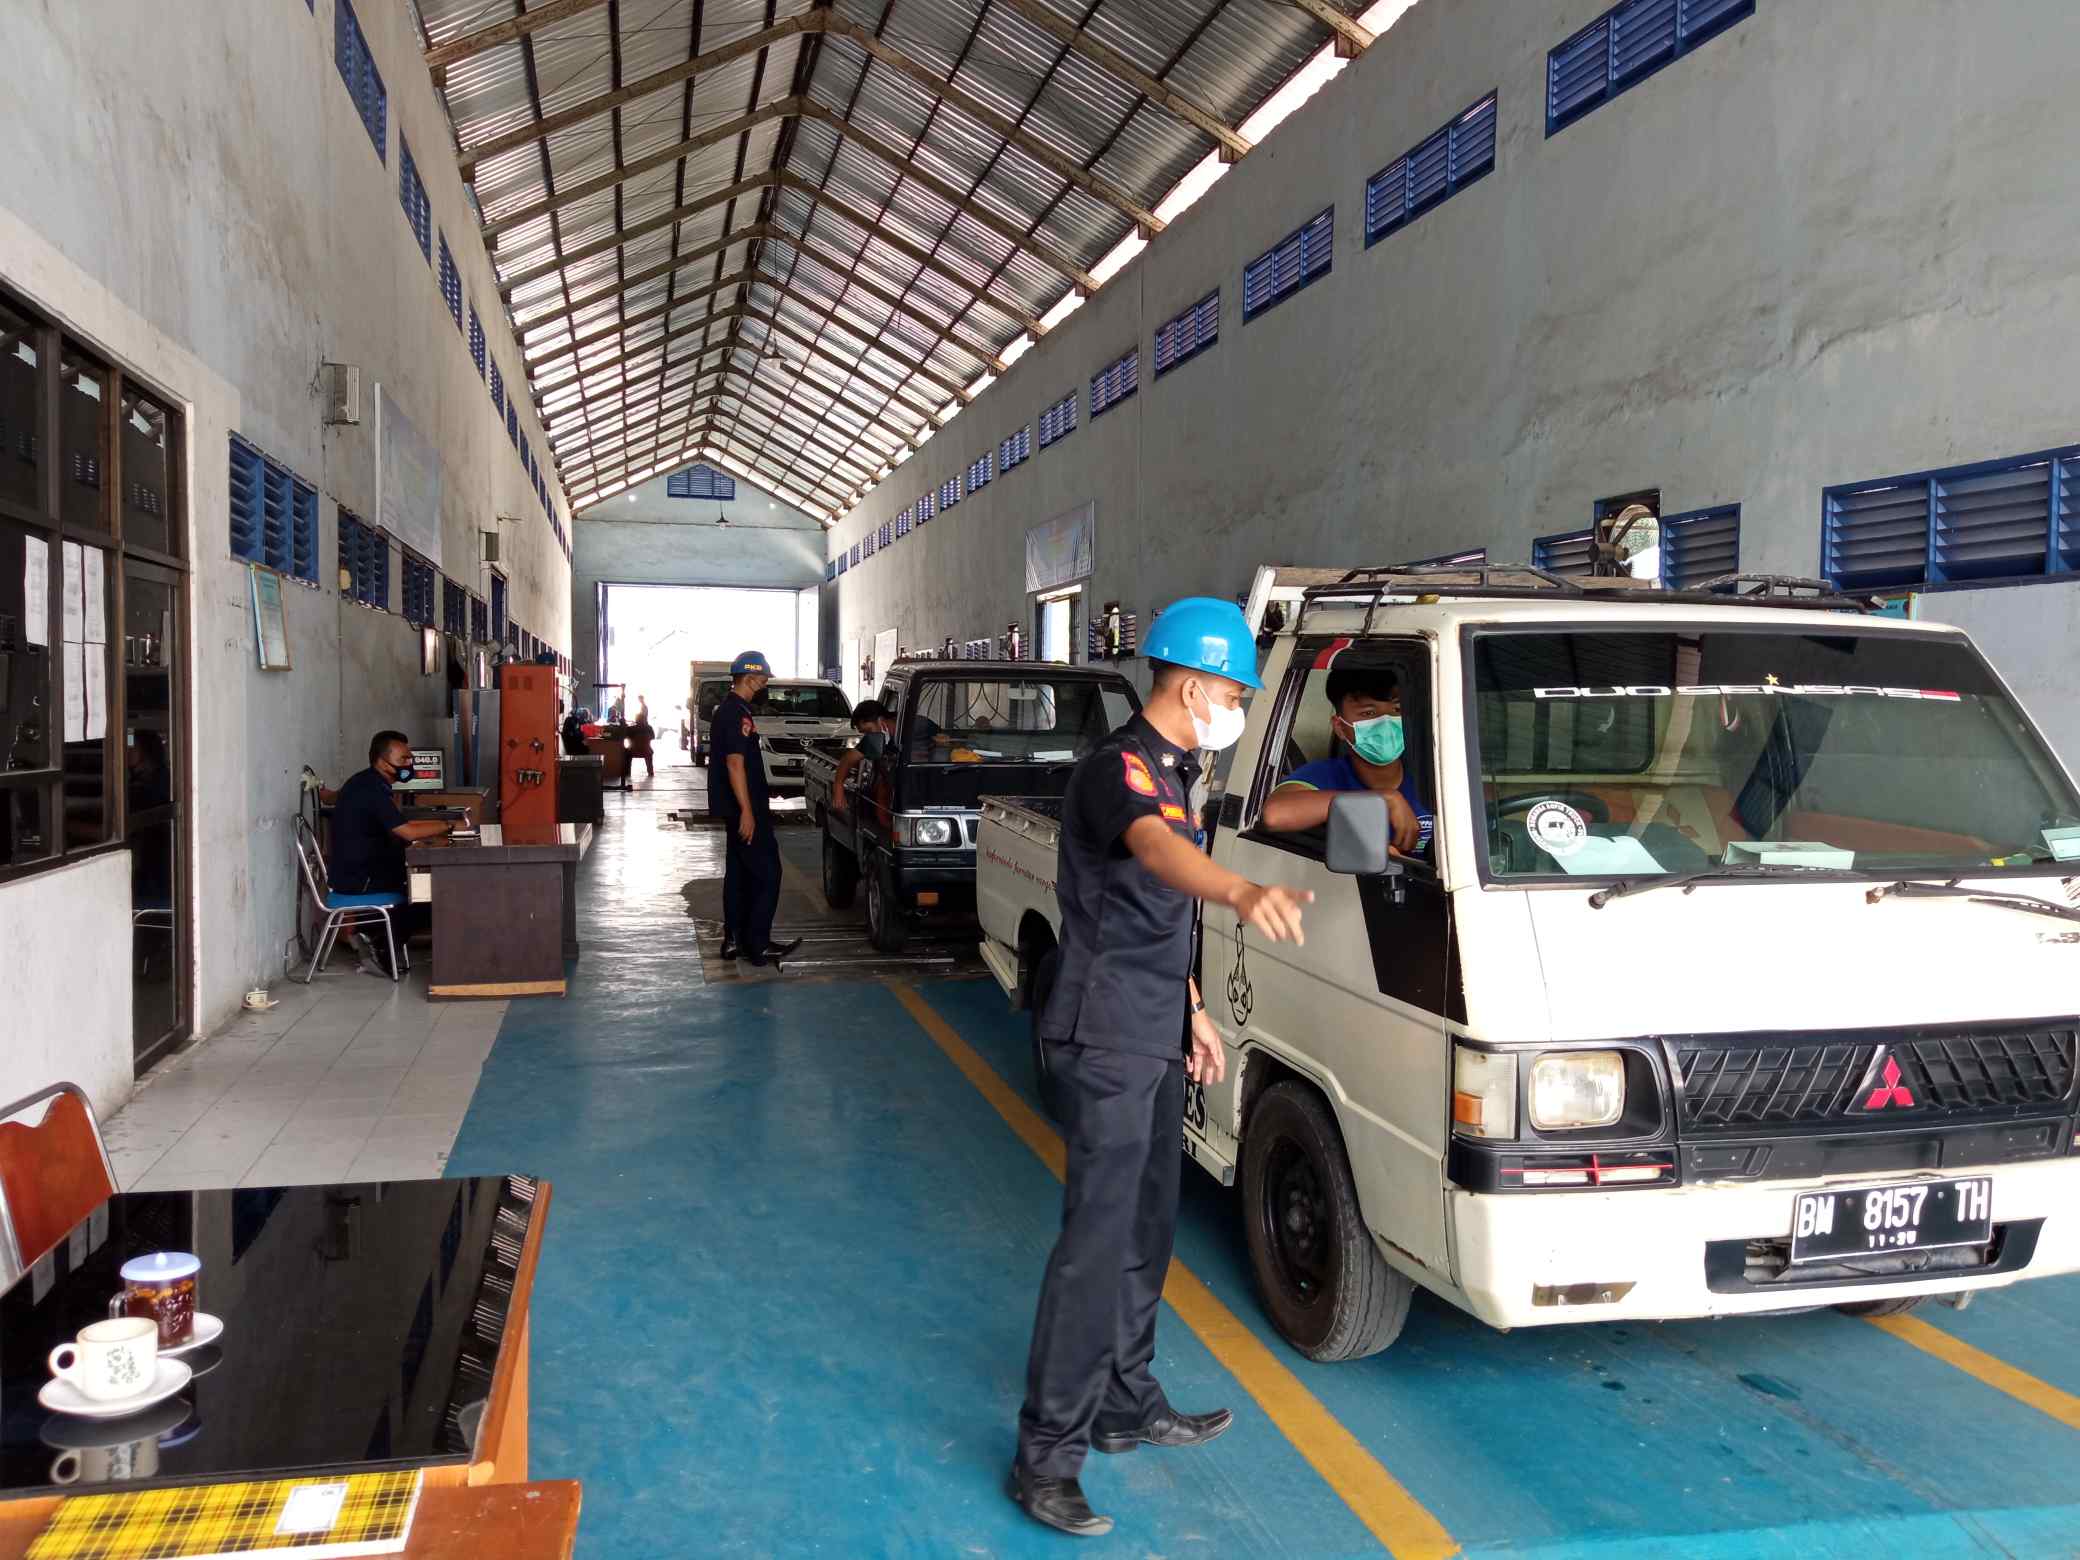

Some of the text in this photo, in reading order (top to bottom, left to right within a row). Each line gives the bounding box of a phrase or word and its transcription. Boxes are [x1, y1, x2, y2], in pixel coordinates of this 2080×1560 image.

[1533, 686, 1671, 698] DUO
[1797, 1180, 1990, 1238] BM 8157 TH
